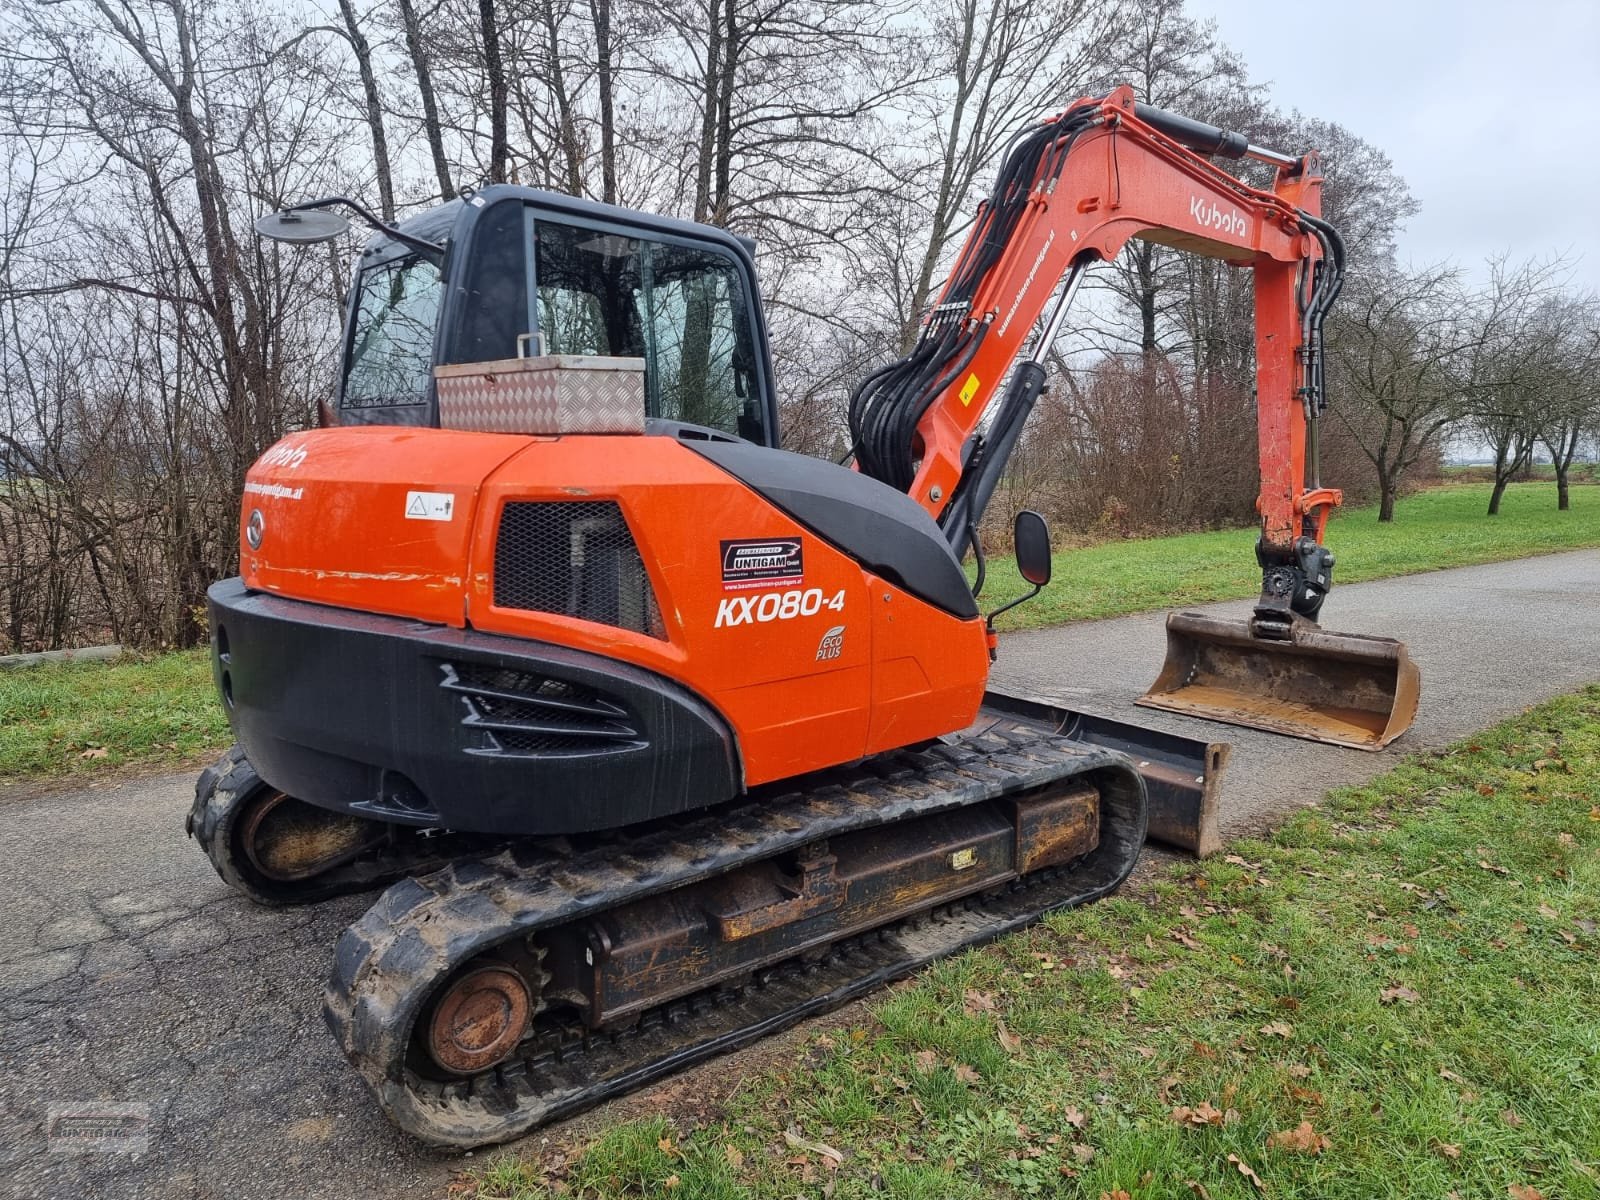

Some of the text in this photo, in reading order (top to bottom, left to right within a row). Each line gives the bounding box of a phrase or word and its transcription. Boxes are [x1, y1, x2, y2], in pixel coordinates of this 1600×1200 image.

[1190, 195, 1246, 238] Kubota
[714, 588, 845, 628] KX080-4
[815, 647, 842, 661] PLUS
[823, 635, 843, 648] eco
